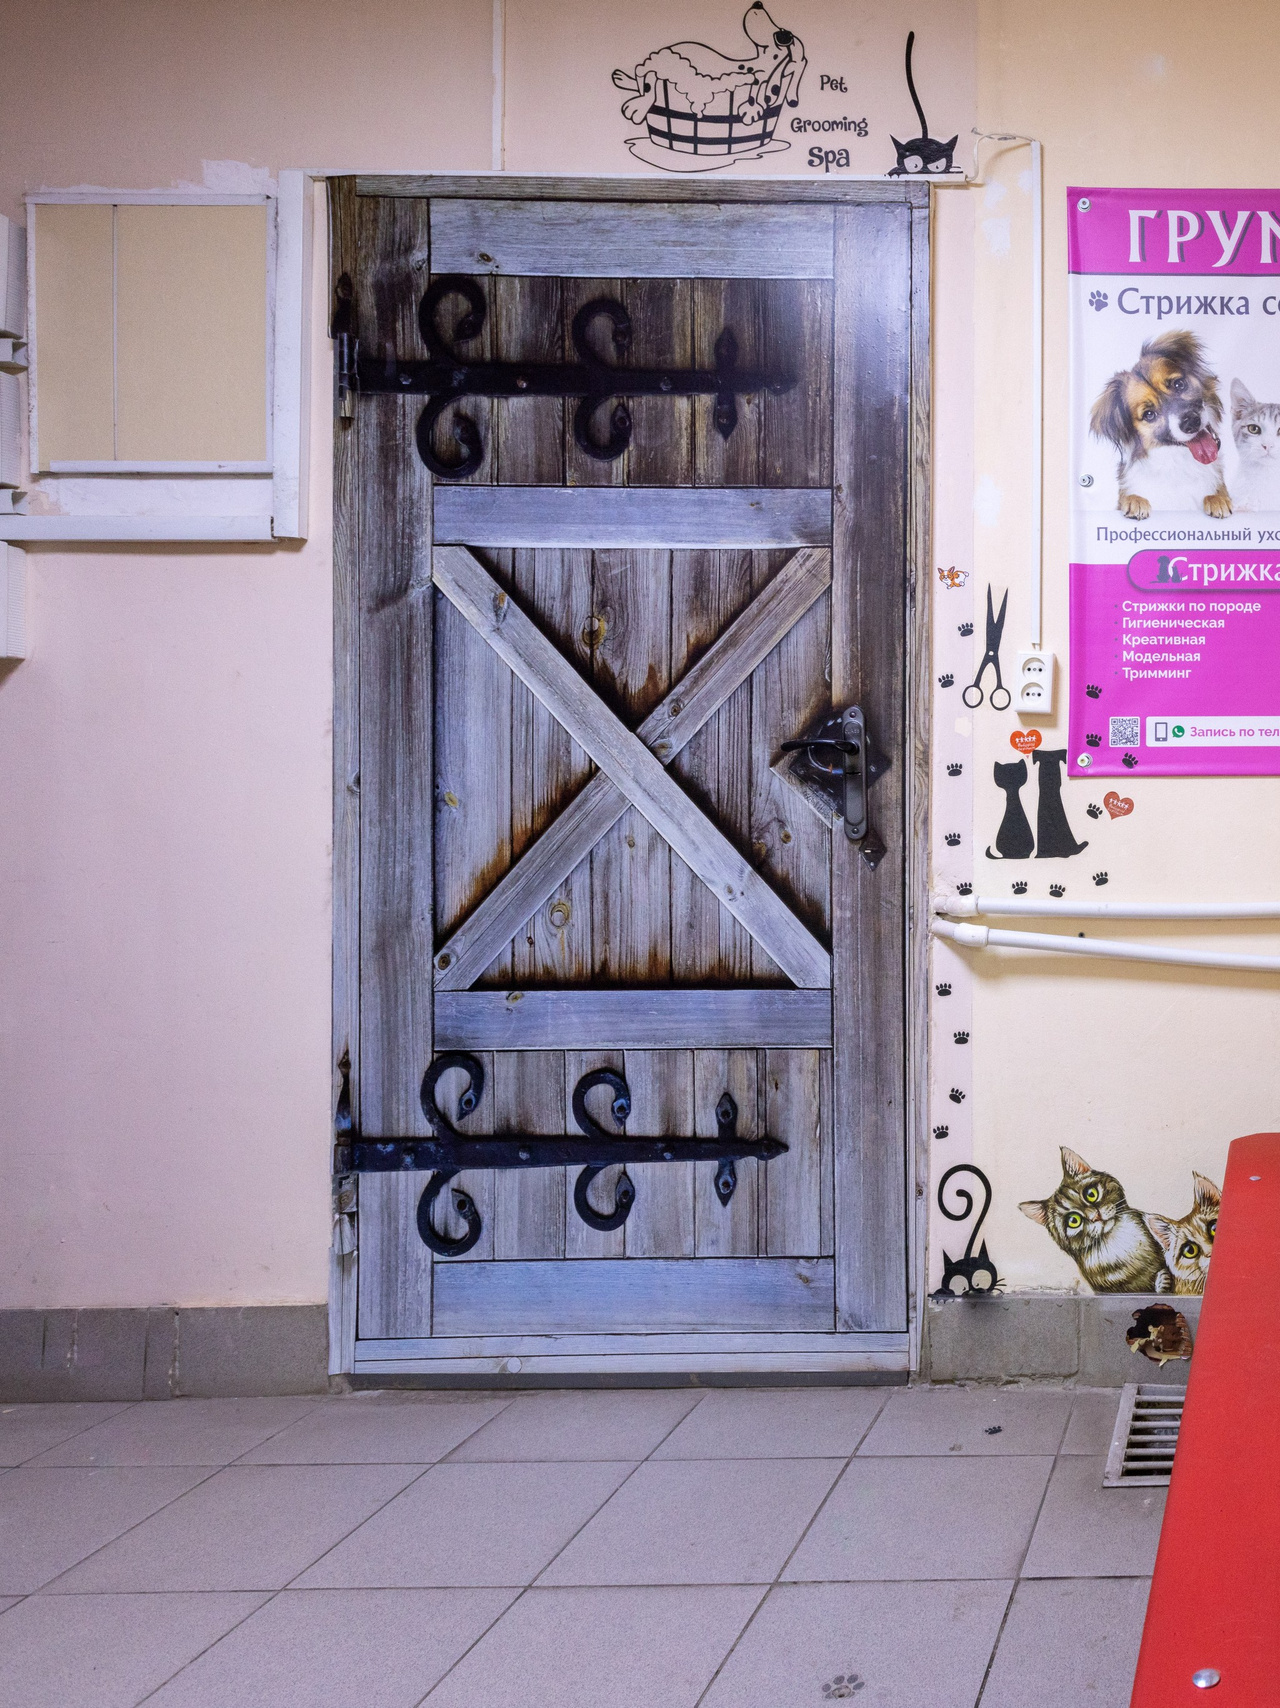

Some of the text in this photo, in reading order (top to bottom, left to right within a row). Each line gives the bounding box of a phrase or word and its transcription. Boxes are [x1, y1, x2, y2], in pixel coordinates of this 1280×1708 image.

[819, 75, 848, 93] Pet
[790, 116, 869, 138] Grooming
[807, 146, 851, 174] Spa
[1117, 287, 1250, 320] Стрижка
[1096, 526, 1252, 544] Профессиональный
[1121, 600, 1262, 614] Стрижки по породе
[1122, 616, 1225, 629] Гигиеническая
[1122, 633, 1206, 647] Креативная
[1122, 650, 1201, 664] Модельная
[1121, 667, 1192, 681] Тримминг
[1189, 726, 1236, 738] Запись
[1238, 728, 1255, 739] по
